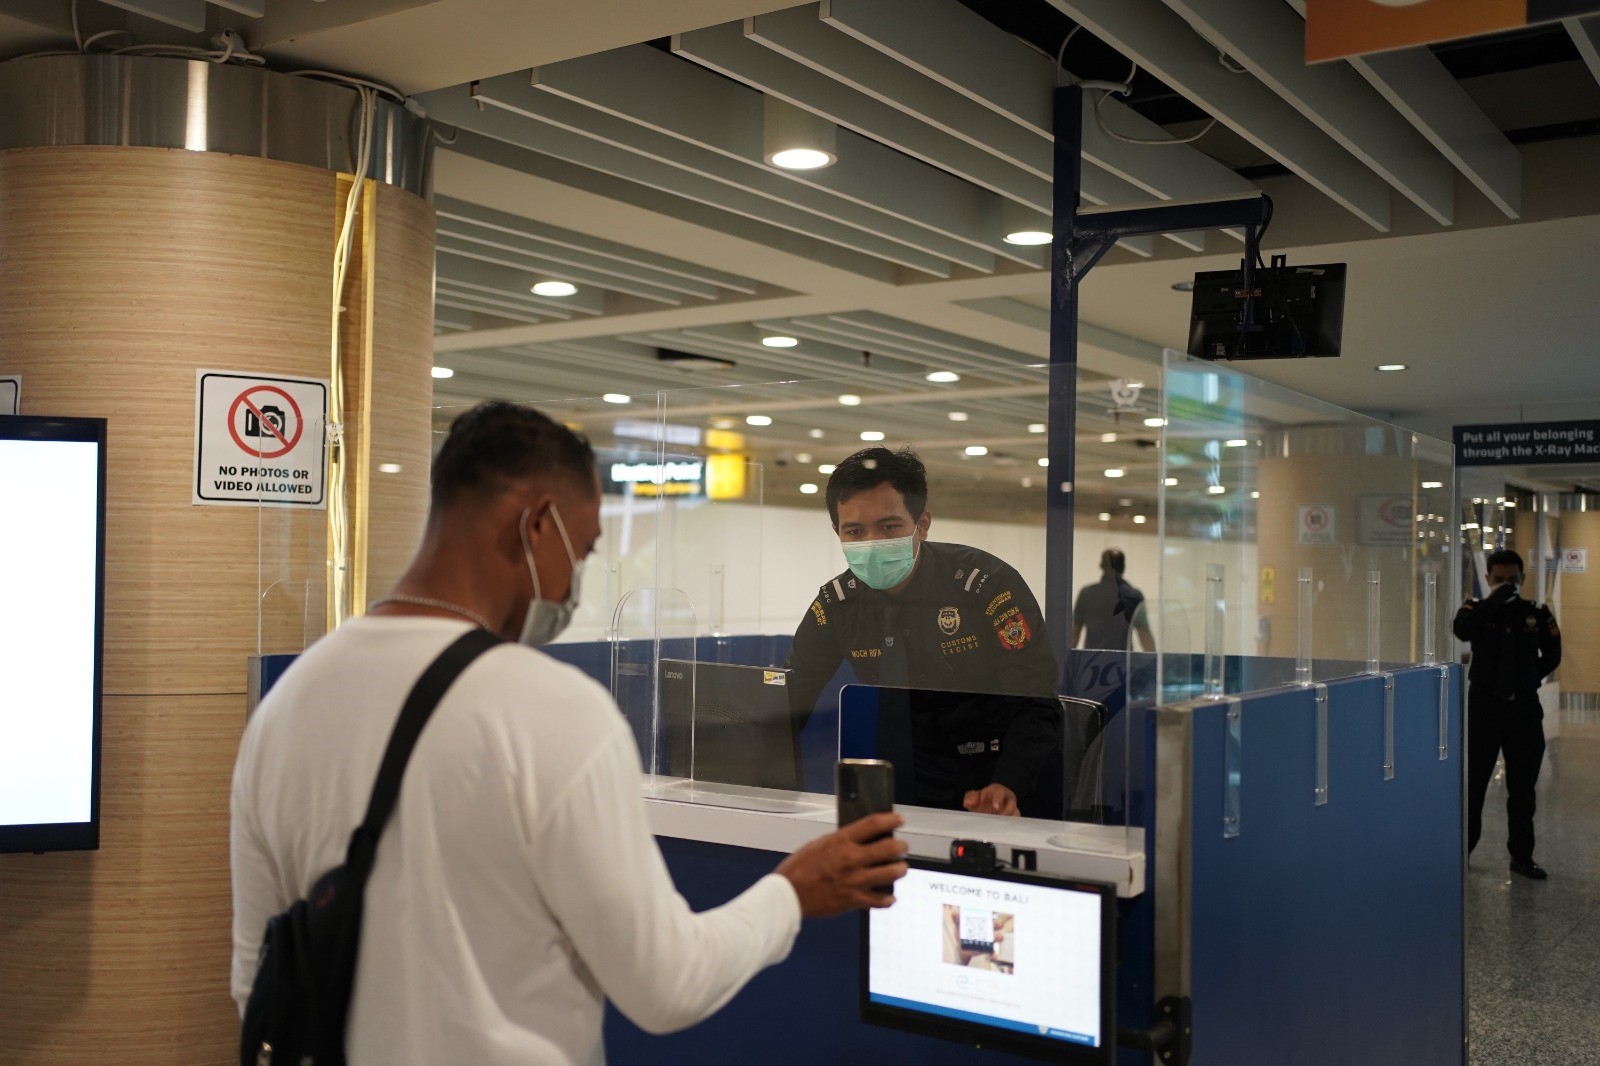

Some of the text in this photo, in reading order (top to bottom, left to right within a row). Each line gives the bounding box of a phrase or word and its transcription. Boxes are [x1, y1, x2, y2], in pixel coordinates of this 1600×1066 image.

[1463, 428, 1594, 444] Put all your belonging
[1463, 443, 1600, 459] through the X-Ray Mac
[219, 466, 309, 480] NO PHOTOS OR
[214, 480, 312, 494] VIDEO ALLOWED
[940, 635, 977, 649] CUSTOMS
[943, 642, 980, 656] EXCISE
[664, 669, 683, 680] Lenovo
[929, 882, 1029, 904] WELCOME TO BALI
